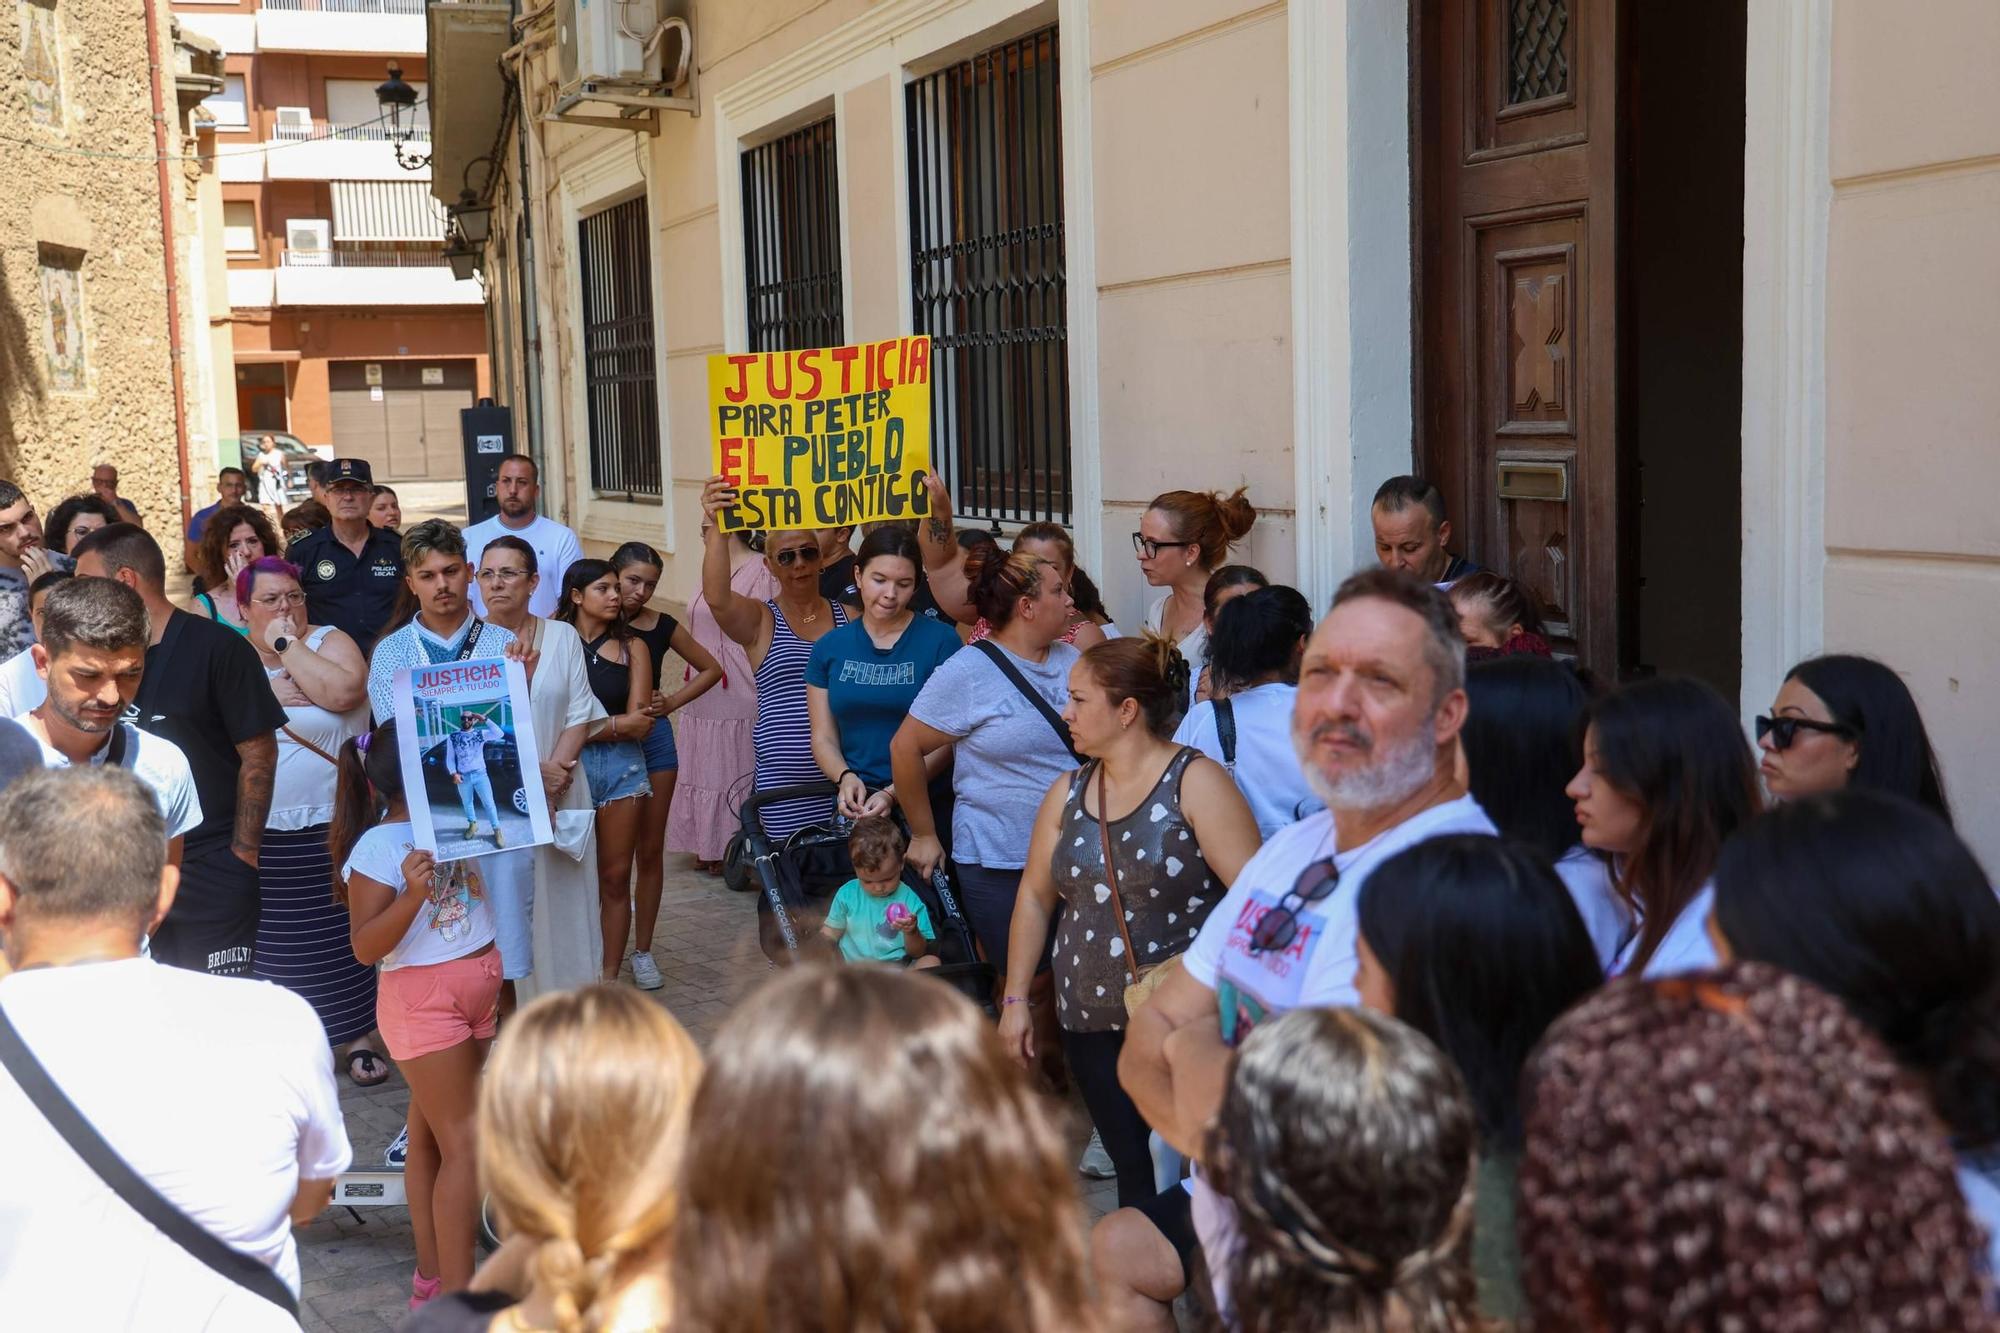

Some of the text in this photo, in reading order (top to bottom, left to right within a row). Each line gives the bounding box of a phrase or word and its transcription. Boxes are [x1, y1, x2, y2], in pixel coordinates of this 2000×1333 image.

[724, 337, 929, 403] JUSTICIA
[718, 388, 891, 437] PARA PETER
[719, 417, 905, 488] EL PUEBLO
[722, 469, 929, 529] ESTA CONTIGO
[417, 663, 502, 689] JUSTICIA
[839, 659, 915, 686] PUMA
[421, 680, 500, 698] SIEMPRE A TU LADO
[941, 888, 957, 910] cool
[775, 904, 791, 927] cool
